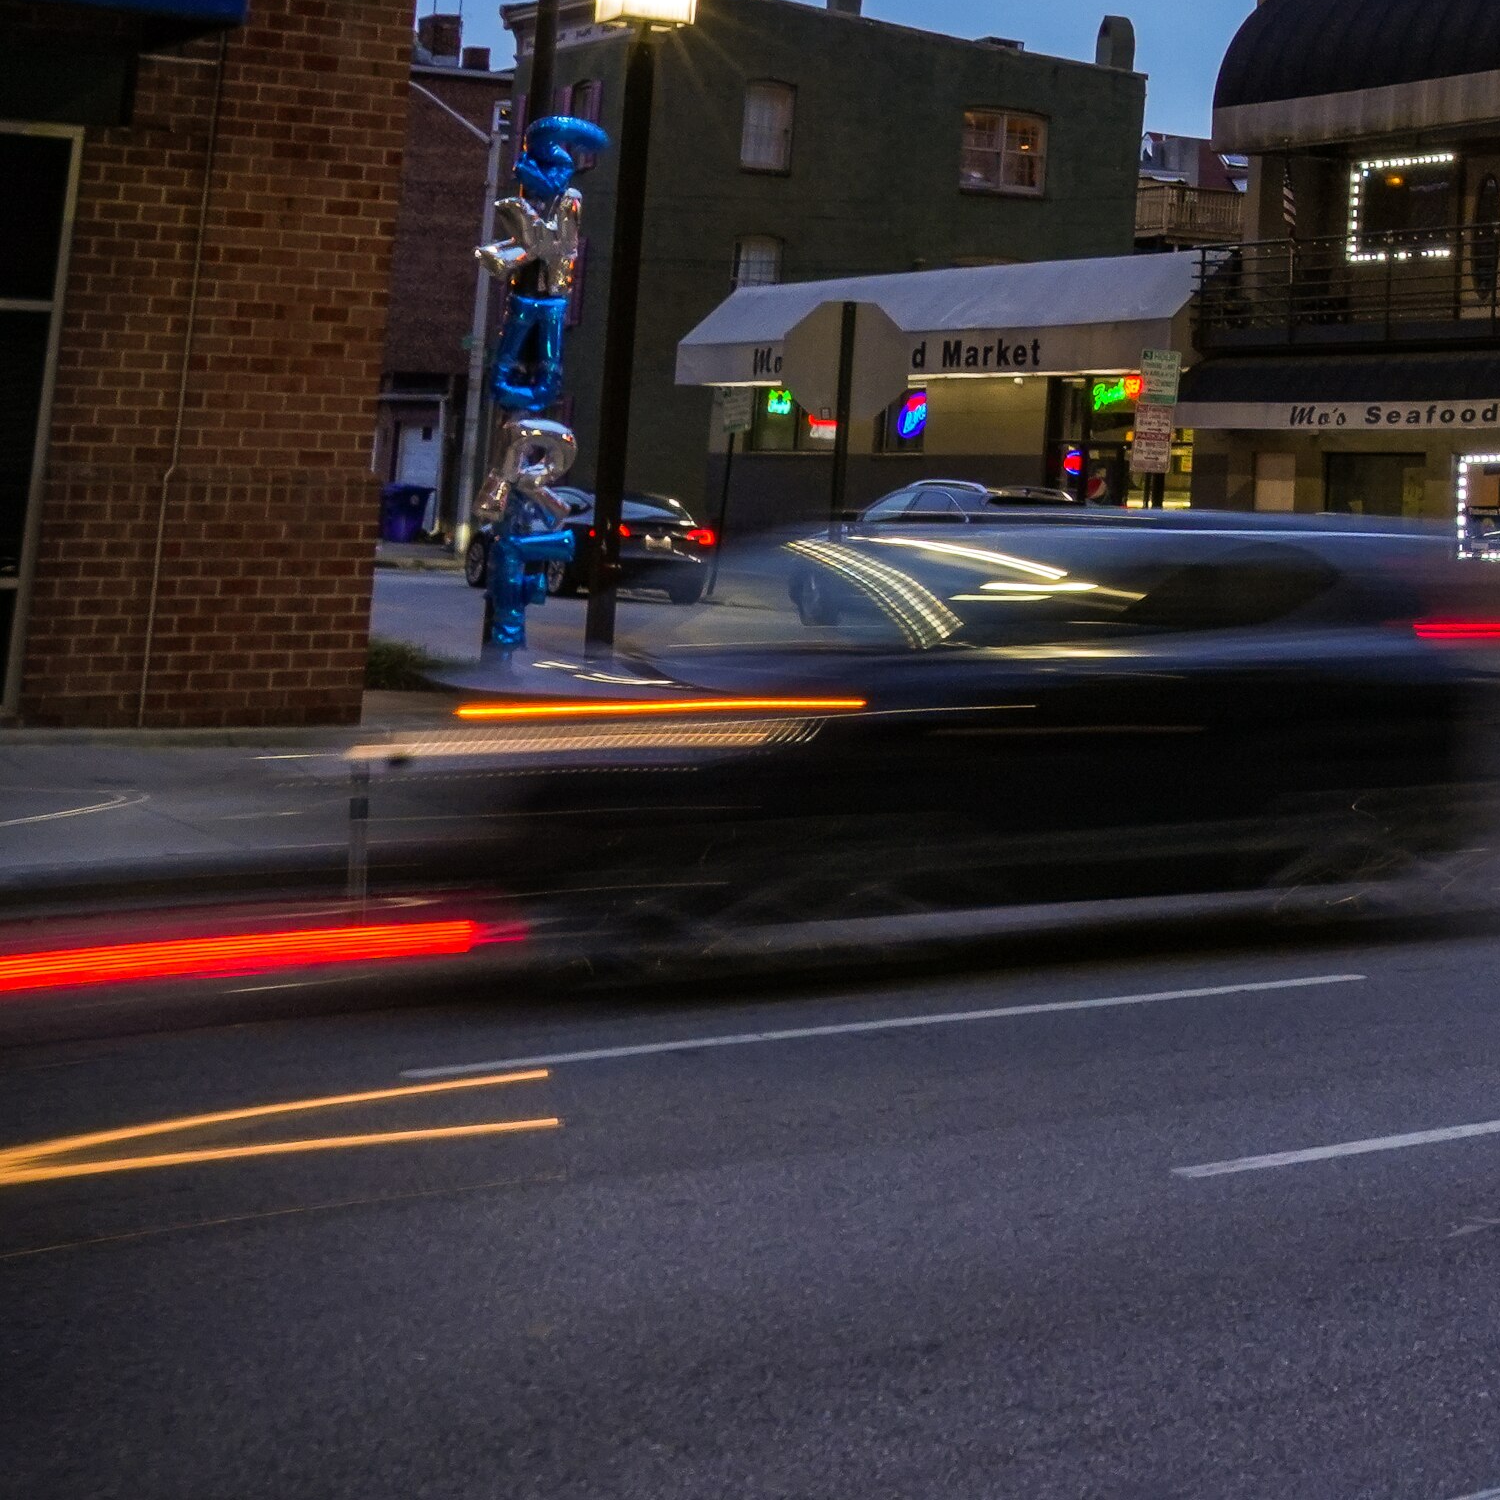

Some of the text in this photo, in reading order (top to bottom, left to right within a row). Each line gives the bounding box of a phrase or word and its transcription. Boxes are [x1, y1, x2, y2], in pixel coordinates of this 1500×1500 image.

[941, 338, 1041, 370] Market
[1289, 405, 1346, 428] Mo's
[1364, 402, 1499, 425] Seafood
